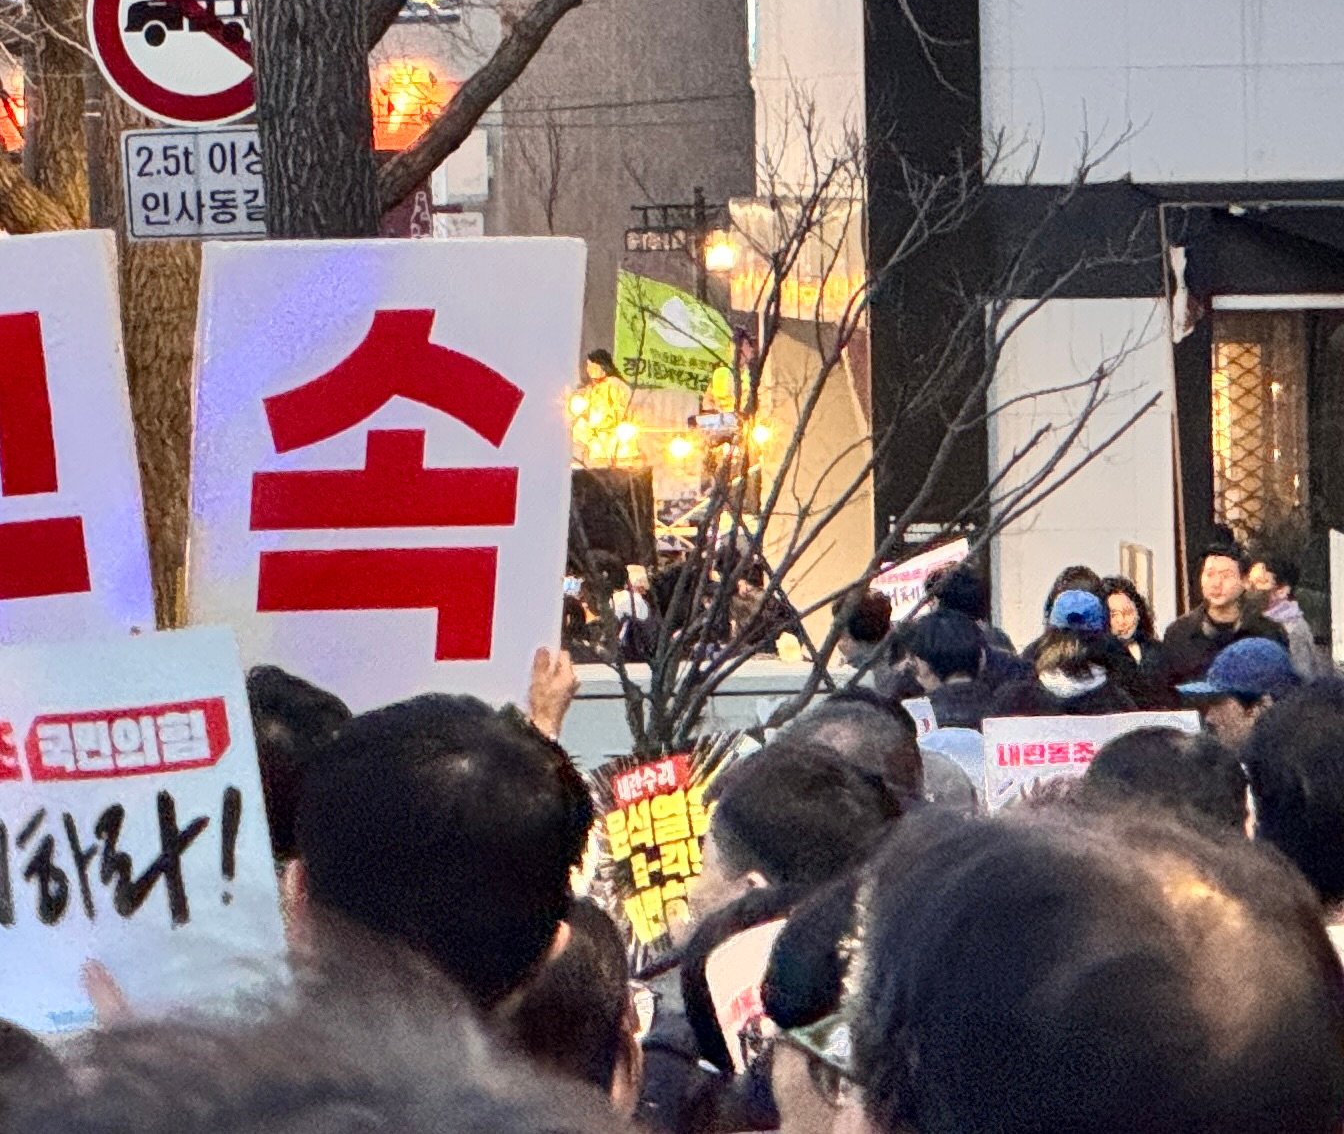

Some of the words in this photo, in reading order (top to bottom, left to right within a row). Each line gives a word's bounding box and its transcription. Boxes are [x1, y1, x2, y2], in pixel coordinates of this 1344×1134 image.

[135, 144, 195, 178] 2.5t
[249, 309, 524, 662] 속
[36, 708, 210, 774] 국민의힘
